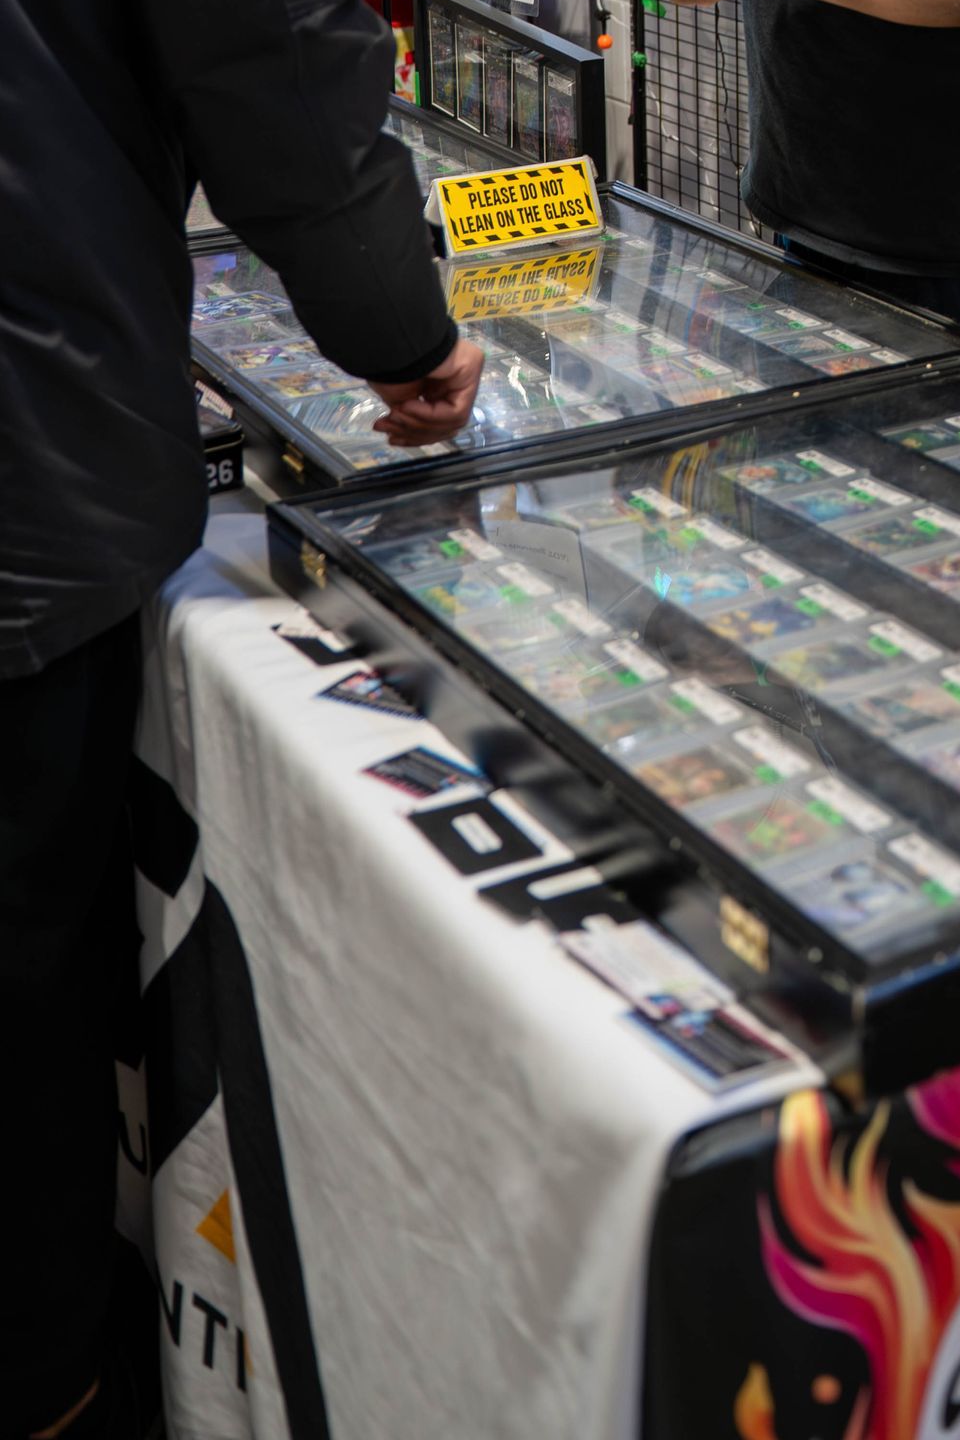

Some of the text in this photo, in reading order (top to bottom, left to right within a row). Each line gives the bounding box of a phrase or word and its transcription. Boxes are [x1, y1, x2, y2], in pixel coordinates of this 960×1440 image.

[468, 178, 565, 209] PLEASE DO NOT
[459, 198, 585, 235] LEAN ON THE GLASS
